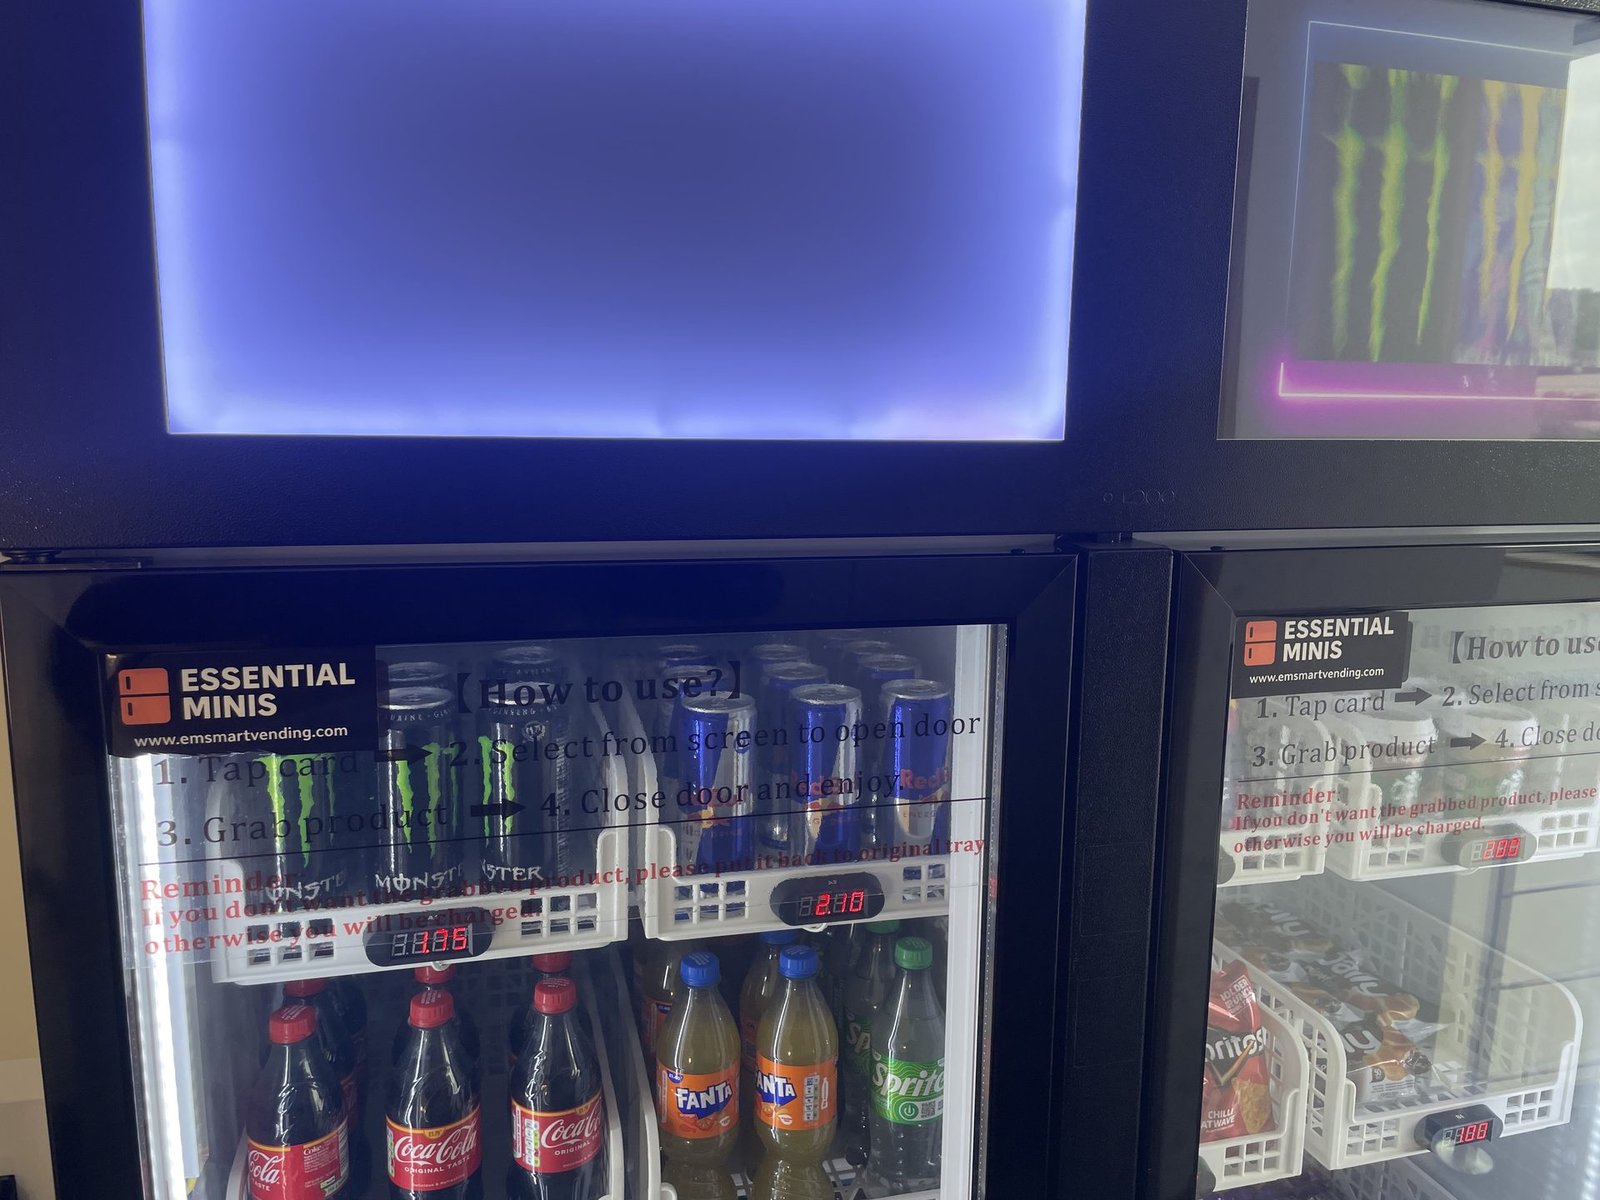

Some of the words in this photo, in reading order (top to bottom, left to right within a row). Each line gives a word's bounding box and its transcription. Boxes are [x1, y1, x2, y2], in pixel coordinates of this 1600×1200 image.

[1284, 616, 1394, 640] ESSENTIAL
[1282, 640, 1343, 662] MINIS
[1535, 635, 1560, 656] to
[1568, 636, 1600, 656] us
[181, 662, 355, 692] ESSENTIAL
[584, 675, 623, 702] to
[1250, 666, 1384, 684] www.emsmartvending.com
[183, 693, 277, 720] MINIS
[1257, 699, 1277, 719] 1.
[1286, 695, 1328, 720] Tap
[1334, 690, 1386, 714] card
[1442, 686, 1462, 707] 2.
[1469, 683, 1536, 705] Select
[1540, 680, 1589, 700] from
[134, 724, 348, 747] www.emsmartvending.com
[448, 741, 481, 767] 2.
[490, 736, 593, 765] Select
[603, 731, 679, 757] from
[688, 722, 788, 751] screen
[799, 721, 826, 743] to
[835, 719, 905, 747] open
[914, 713, 981, 738] door
[1495, 729, 1514, 749] 4.
[1521, 725, 1577, 748] Close
[1582, 720, 1600, 741] do
[1252, 747, 1274, 768] 3.
[1281, 742, 1338, 766] Grab
[1343, 736, 1437, 766] product
[155, 759, 187, 785] 1.
[199, 755, 266, 788] Tap
[278, 752, 359, 777] card
[541, 792, 570, 817] 4.
[581, 788, 667, 814] Close
[677, 782, 749, 807] door
[757, 774, 812, 801] and
[820, 770, 904, 801] enjoy.
[1287, 807, 1332, 828] don't
[1335, 806, 1376, 823] want
[1381, 801, 1406, 817] the
[1410, 795, 1476, 818] grabbed
[1480, 790, 1546, 812] product,
[1550, 786, 1597, 806] please
[158, 820, 191, 847] 3.
[203, 811, 292, 844] Grab
[303, 804, 447, 846] product
[1234, 833, 1321, 853] otherwise
[1325, 831, 1355, 848] you
[1359, 825, 1390, 842] will
[1394, 823, 1413, 838] be
[1417, 816, 1485, 835] charged.
[168, 904, 218, 929] you
[303, 890, 366, 911] want
[636, 859, 709, 882] please
[755, 852, 774, 869] it
[778, 846, 829, 868] back
[833, 845, 854, 862] to
[859, 837, 942, 863] original
[944, 837, 985, 859] tray
[815, 891, 864, 916] 2.10
[144, 924, 283, 956] otherwise
[289, 920, 337, 949] you
[343, 912, 393, 937] will
[422, 926, 468, 954] 1.75
[1204, 1027, 1267, 1063] oritos
[676, 1081, 732, 1110] FANTA
[758, 1070, 796, 1098] ANTA
[1201, 1113, 1236, 1129] ATWAVE
[394, 1119, 477, 1165] Coca-Cola
[554, 1140, 590, 1156] ORIGINAL
[404, 1165, 445, 1174] ORIGINAL
[447, 1154, 470, 1169] TASTE
